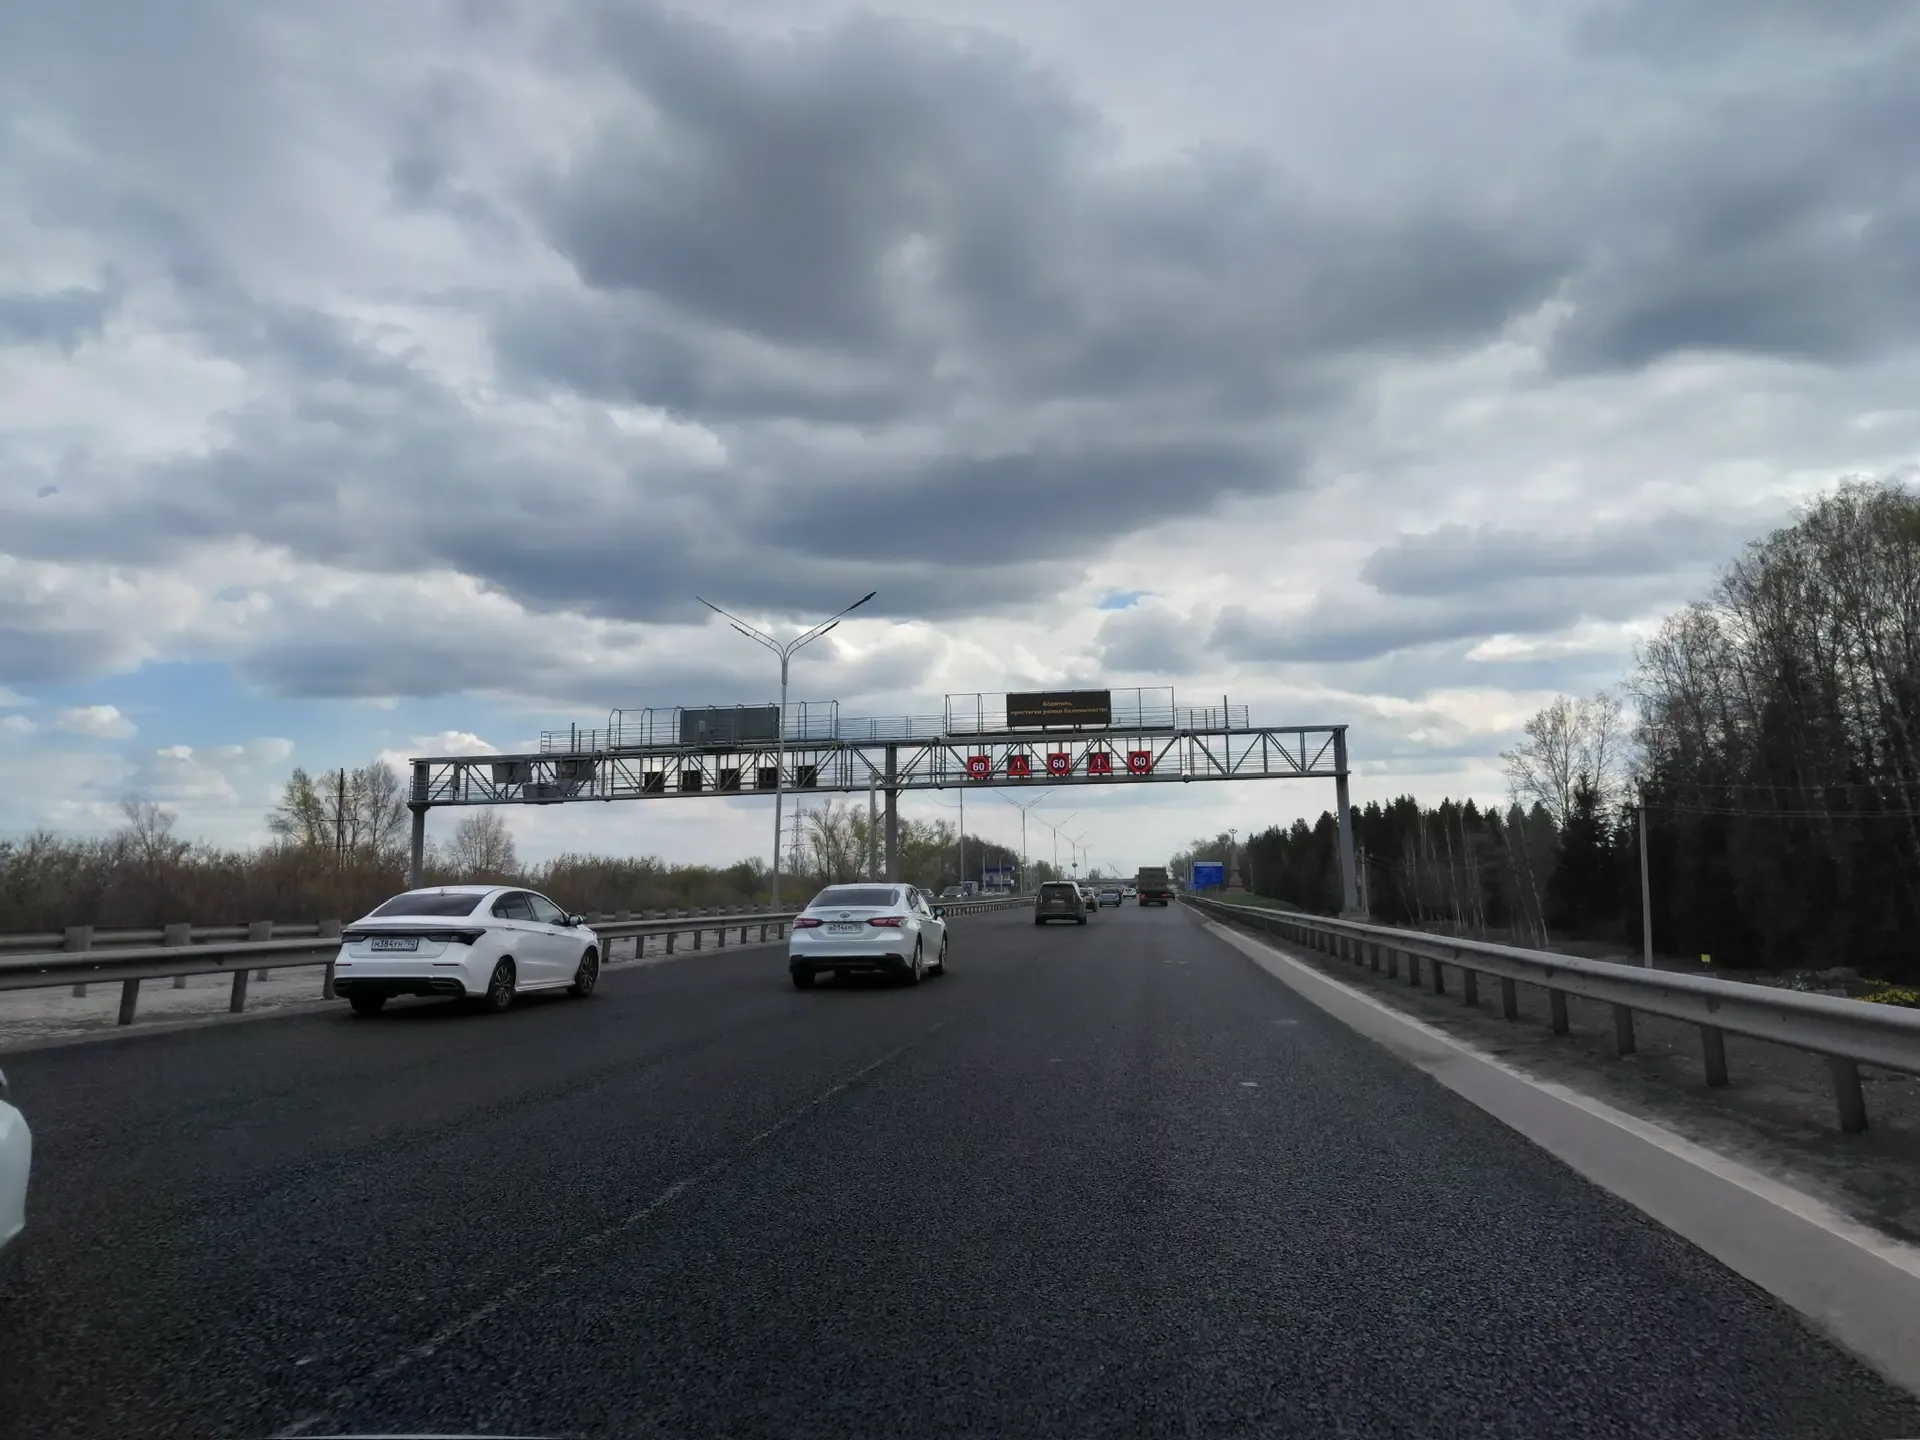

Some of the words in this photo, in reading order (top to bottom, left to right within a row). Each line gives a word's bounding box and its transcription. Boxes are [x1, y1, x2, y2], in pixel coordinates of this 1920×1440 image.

[1052, 759, 1065, 768] 60
[1133, 756, 1146, 766] 60
[972, 762, 985, 771] 60
